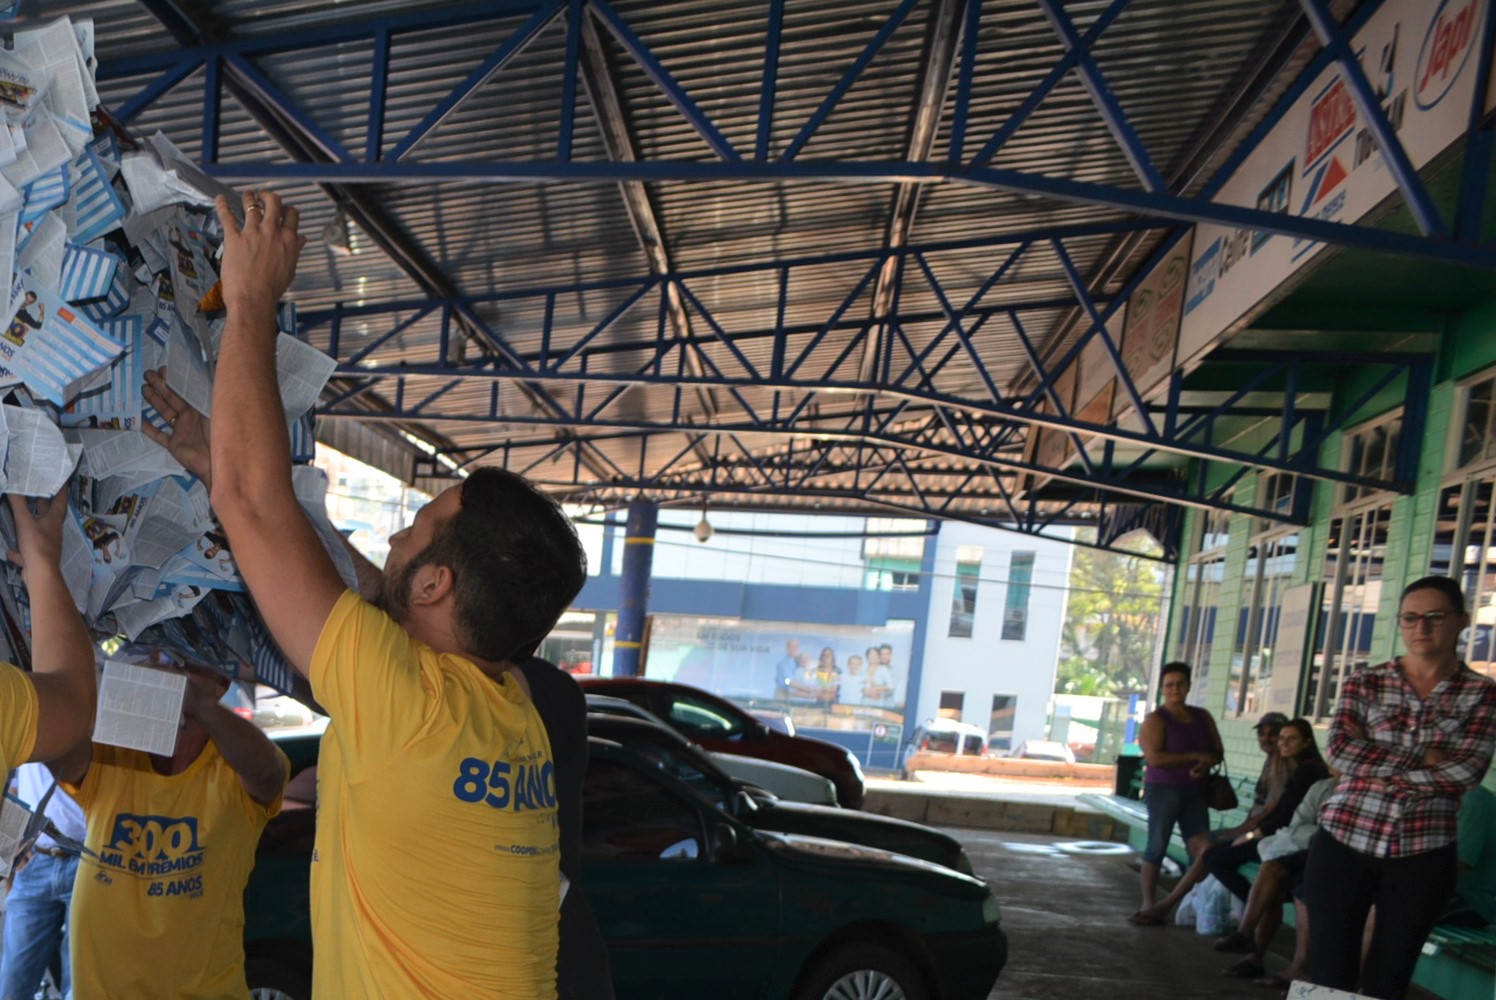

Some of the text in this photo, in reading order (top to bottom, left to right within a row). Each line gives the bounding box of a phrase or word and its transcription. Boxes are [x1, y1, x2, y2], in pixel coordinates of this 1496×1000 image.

[453, 757, 512, 808] 85
[116, 819, 193, 860] 300
[100, 851, 127, 870] MIL
[147, 882, 164, 897] 85
[165, 875, 203, 896] ANOS
